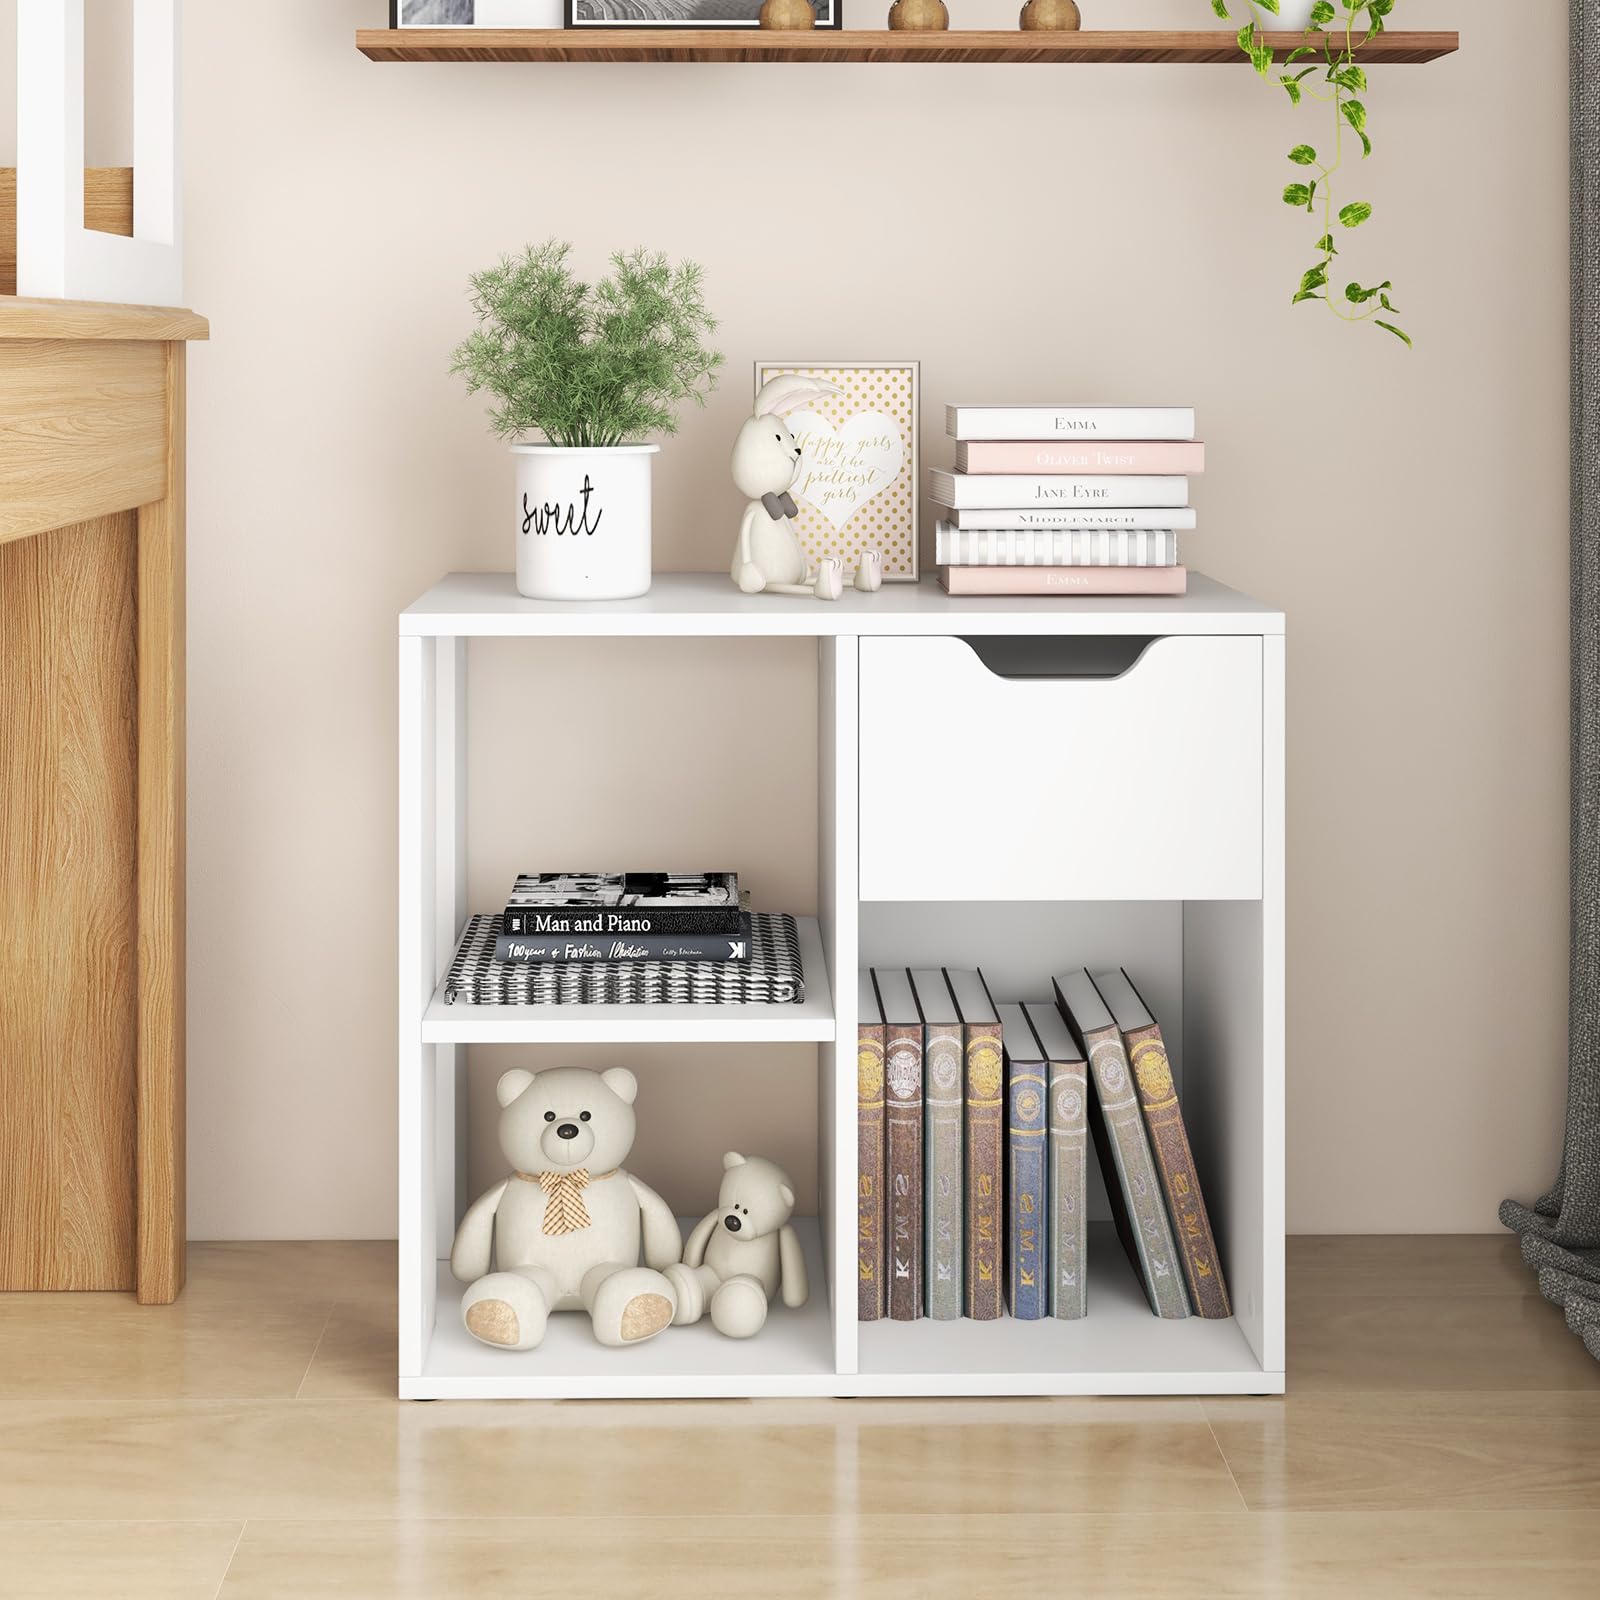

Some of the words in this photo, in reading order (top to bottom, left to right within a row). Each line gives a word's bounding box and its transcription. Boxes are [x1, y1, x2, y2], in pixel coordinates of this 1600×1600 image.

[1055, 417, 1097, 430] EMMA
[856, 436, 892, 454] girls
[816, 457, 834, 466] are
[840, 455, 865, 467] the
[821, 486, 858, 505] girls
[1034, 485, 1068, 499] JANE
[1073, 485, 1110, 498] EYRE
[521, 473, 603, 536] sweet
[535, 914, 570, 932] Man
[574, 914, 603, 932] and
[607, 914, 651, 932] Piano
